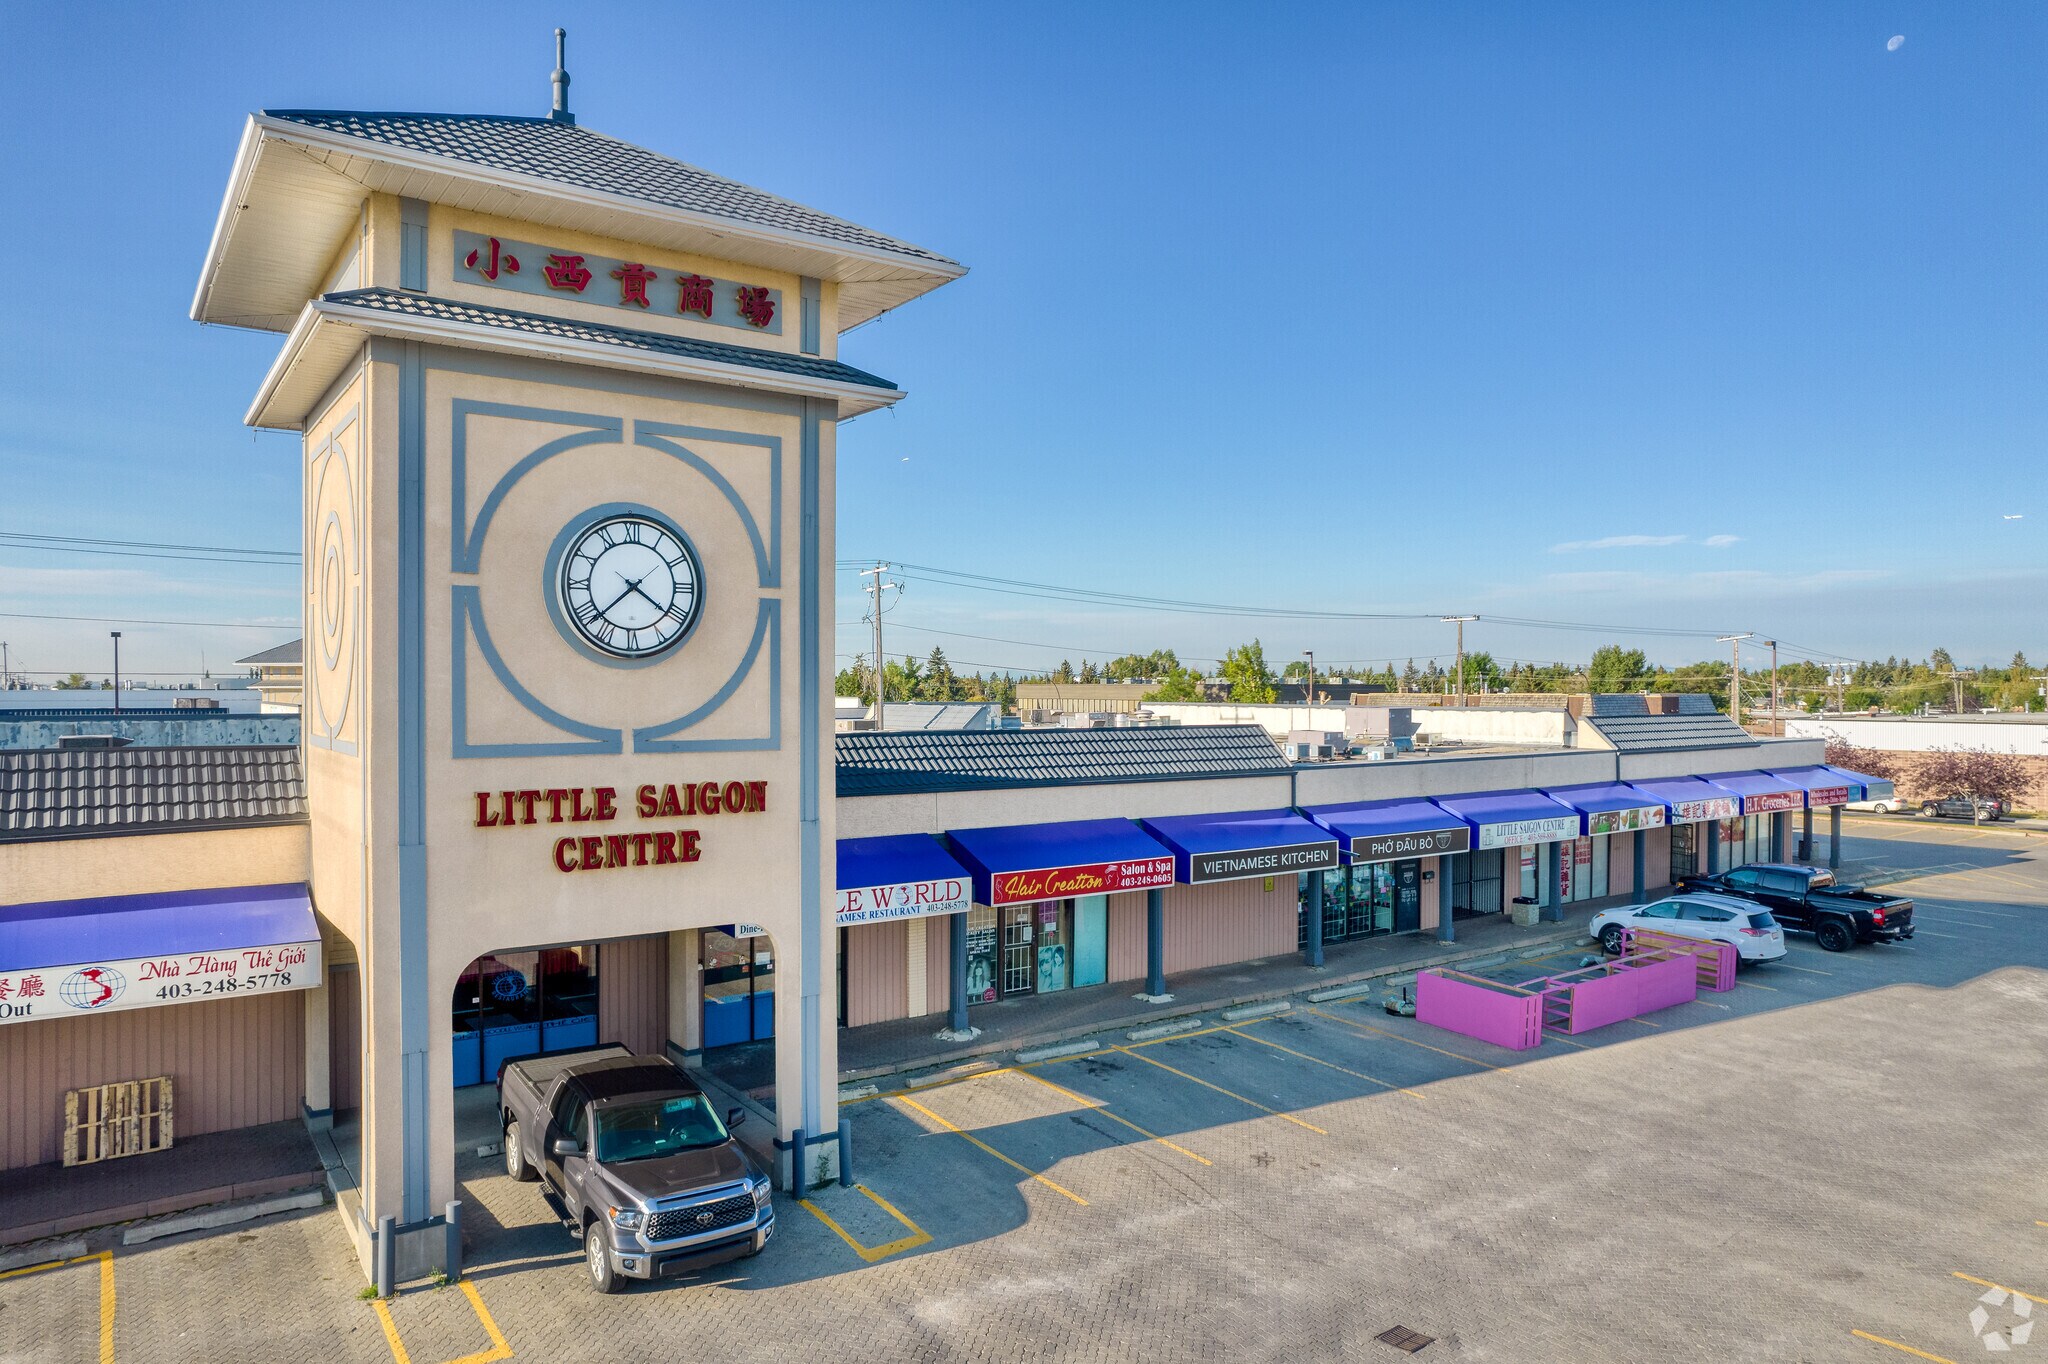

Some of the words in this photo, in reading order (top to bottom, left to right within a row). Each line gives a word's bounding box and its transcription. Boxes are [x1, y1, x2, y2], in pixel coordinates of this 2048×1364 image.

[464, 237, 776, 328] 小西貢商場
[595, 527, 616, 550] XI
[624, 523, 641, 543] XII
[575, 548, 597, 566] X
[667, 555, 687, 568] II
[569, 577, 590, 590] IX
[674, 582, 693, 593] III
[596, 620, 616, 645] VII
[626, 630, 640, 649] VI
[653, 624, 669, 645] V
[474, 787, 617, 827] LITTLE
[636, 780, 768, 818] SAIGON
[1747, 797, 1760, 812] H.T.
[1761, 795, 1790, 810] Groceries
[1496, 823, 1518, 836] LITTLE
[1520, 821, 1541, 835] SAIGON
[1543, 819, 1566, 832] CENTRE
[553, 829, 702, 873] CENTRE
[1372, 838, 1394, 855] PHỞ
[1419, 835, 1433, 850] BÒ
[1121, 863, 1146, 876] Salon
[1147, 861, 1154, 873] &
[1155, 860, 1171, 874] Spa
[1203, 853, 1278, 874] VIETNAMESE
[1280, 849, 1329, 866] KITCHEN
[1004, 874, 1042, 900] Hair
[1045, 870, 1103, 895] Creation
[1120, 873, 1172, 887] 403-248-0605
[836, 911, 867, 923] AMESE
[869, 905, 922, 920] RESTAURANT
[926, 900, 969, 913] 403-248-5778
[740, 925, 764, 934] Dine-
[138, 960, 181, 981] Nhà
[186, 955, 237, 977] Hàng
[243, 949, 273, 971] Thế
[275, 946, 306, 973] Giới
[155, 971, 292, 1000] 403-248-5778
[0, 1002, 33, 1018] Out
